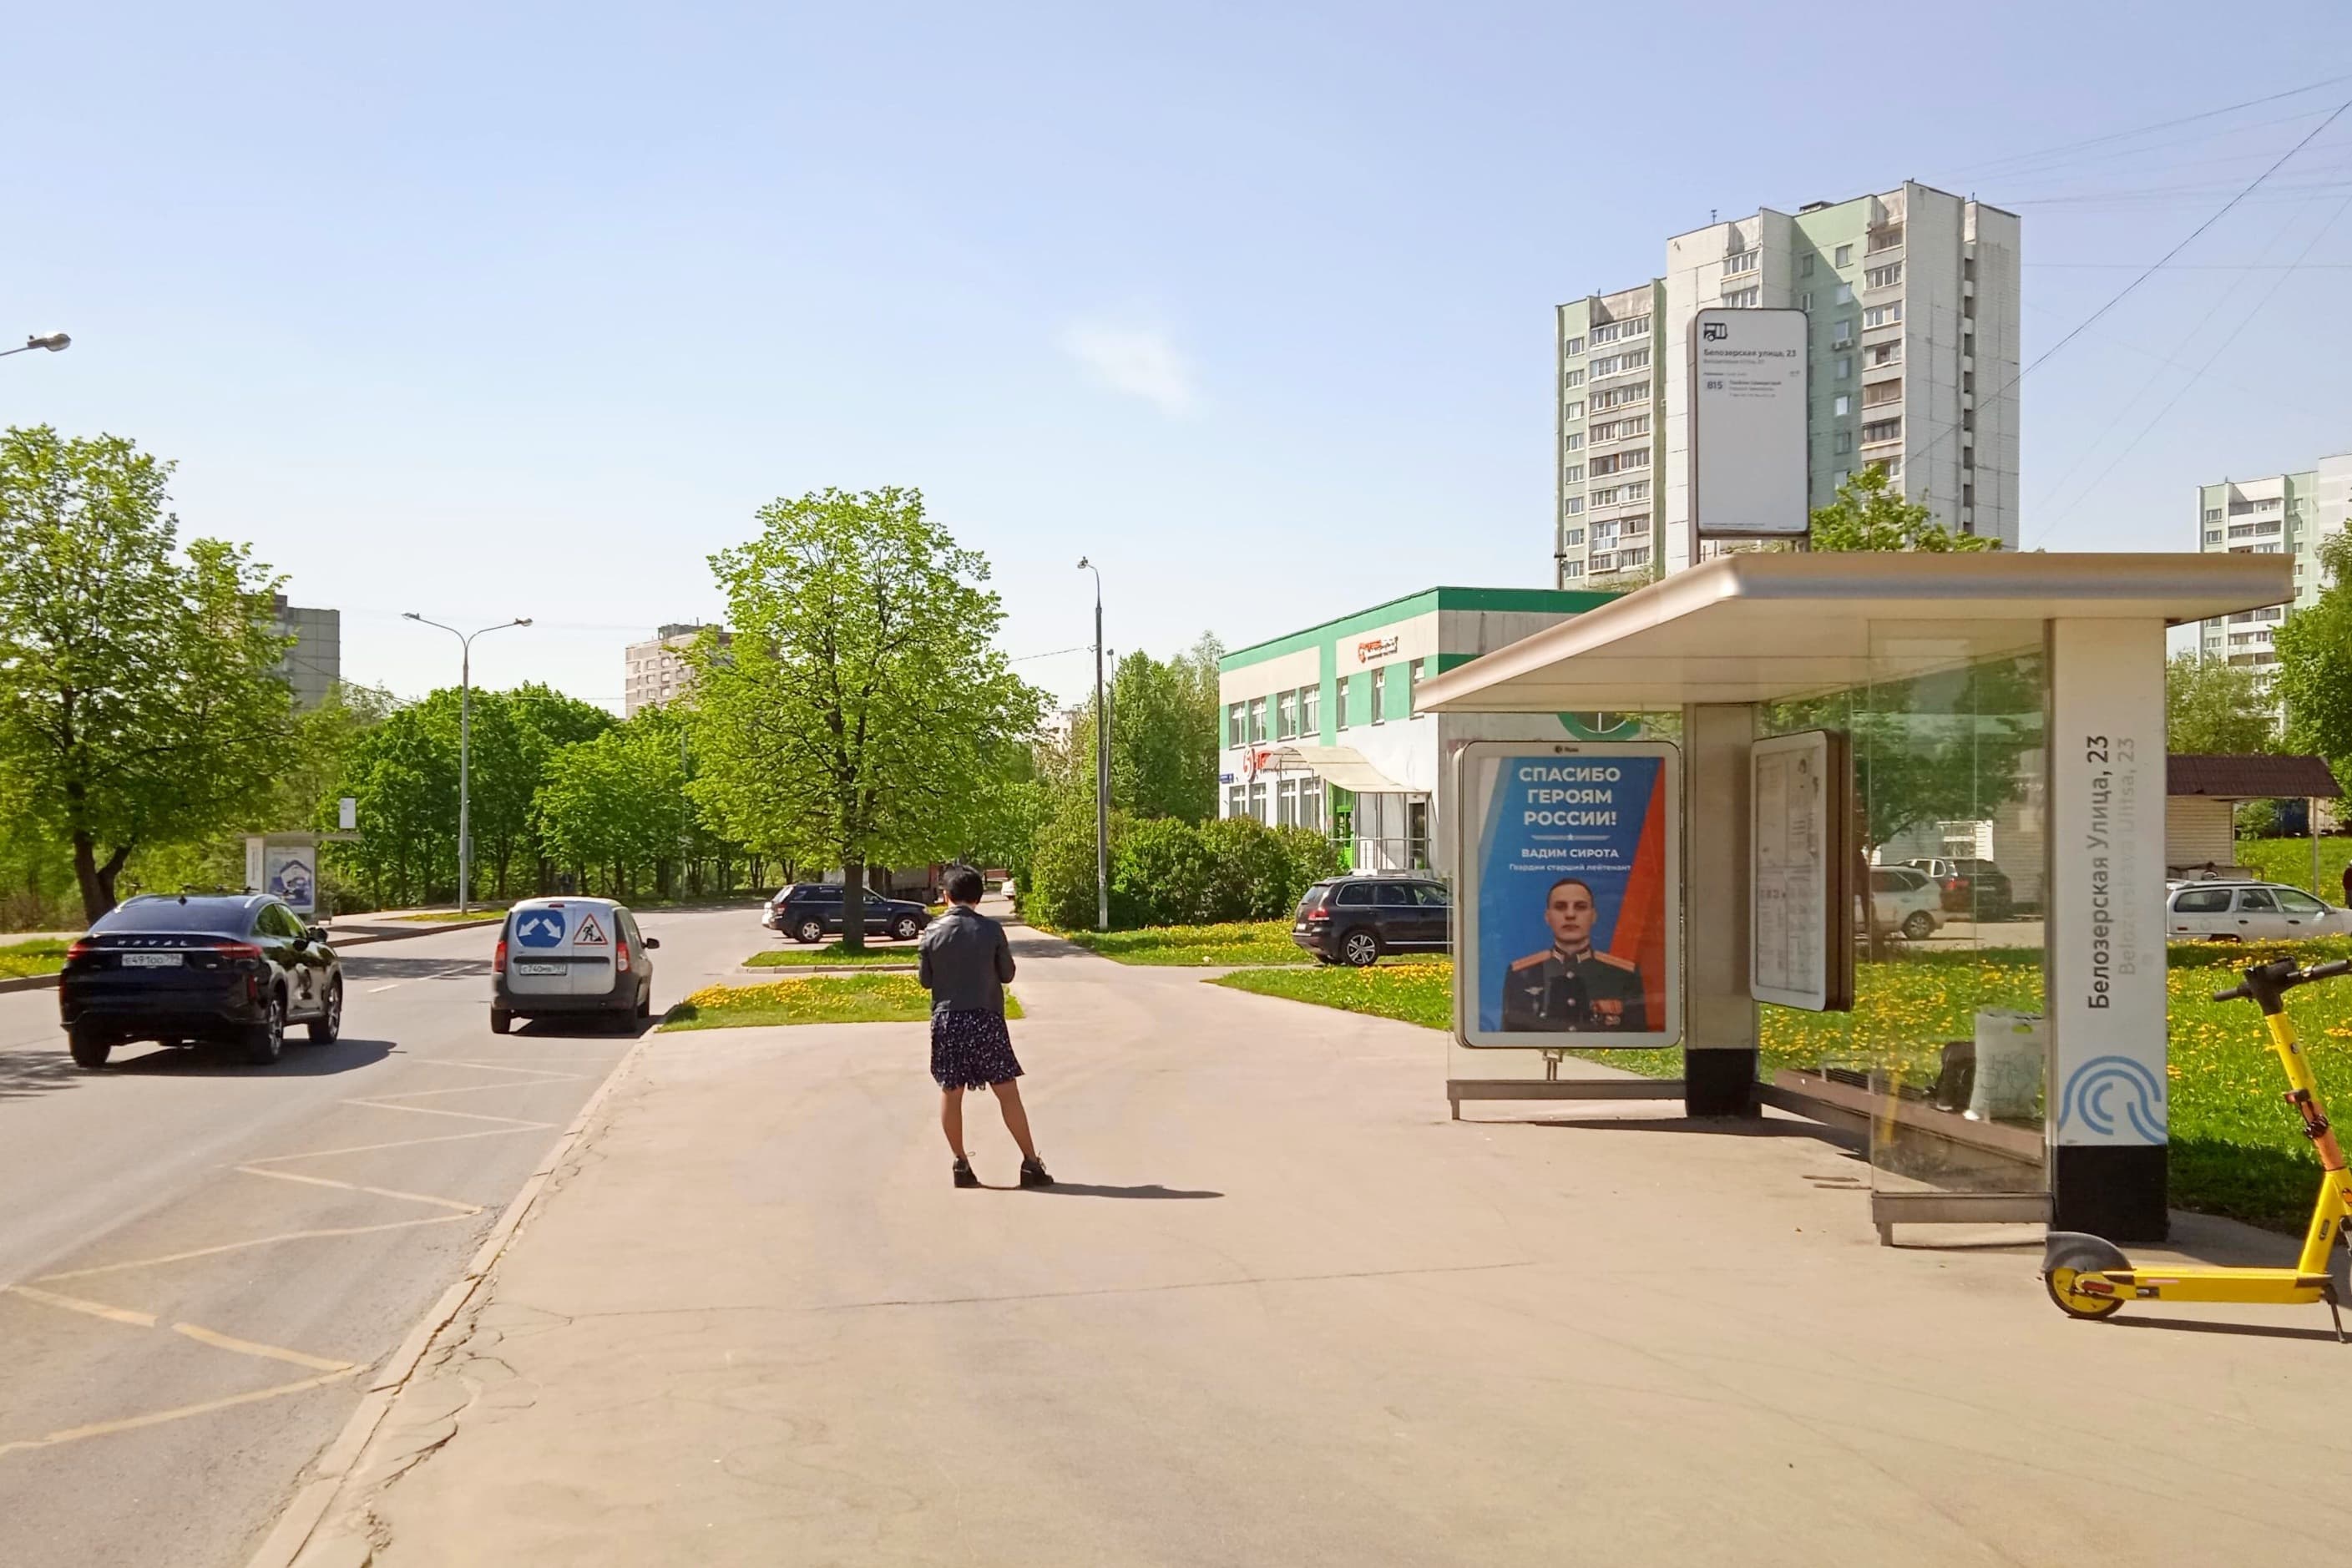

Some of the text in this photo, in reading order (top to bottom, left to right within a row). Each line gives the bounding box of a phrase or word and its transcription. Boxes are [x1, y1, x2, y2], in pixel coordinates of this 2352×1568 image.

[1703, 348, 1757, 358] Белозерская
[1786, 349, 1797, 357] 23
[2117, 737, 2135, 762] 23
[1518, 766, 1621, 782] СПАСИБО
[1527, 789, 1612, 804] ГЕРОЯМ
[1523, 811, 1617, 827] РОССИИ!
[1520, 848, 1620, 859] ВАДИМ СИРОТА
[1546, 863, 1586, 872] старший
[1586, 863, 1631, 872] лейтенант
[2086, 735, 2114, 1009] Белозерская Улица, 23
